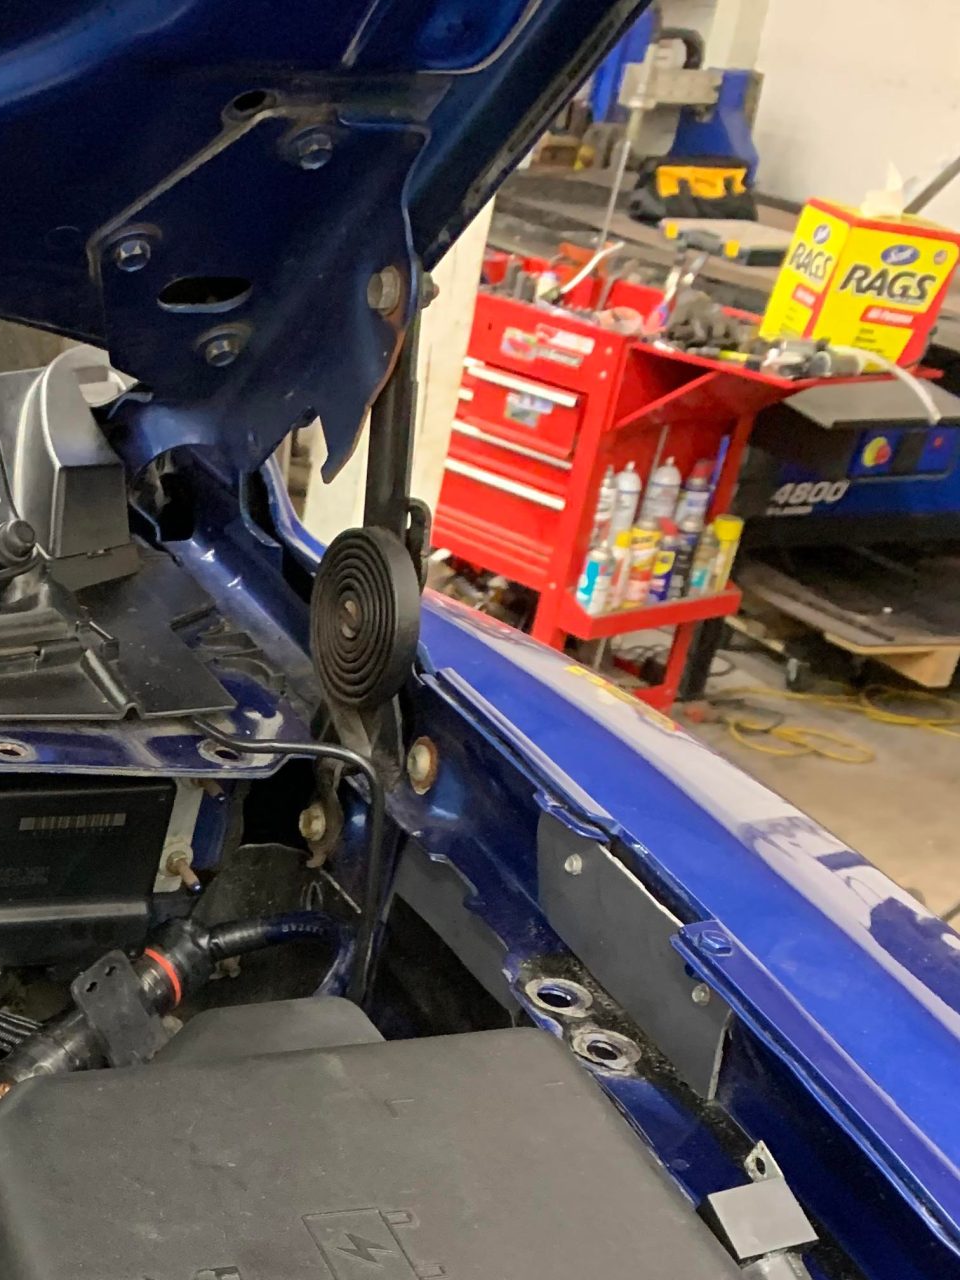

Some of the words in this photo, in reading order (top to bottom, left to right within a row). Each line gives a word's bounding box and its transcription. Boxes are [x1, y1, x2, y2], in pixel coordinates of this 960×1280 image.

[790, 243, 832, 280] RAGS
[840, 264, 936, 301] RAGS
[771, 480, 850, 504] 4800
